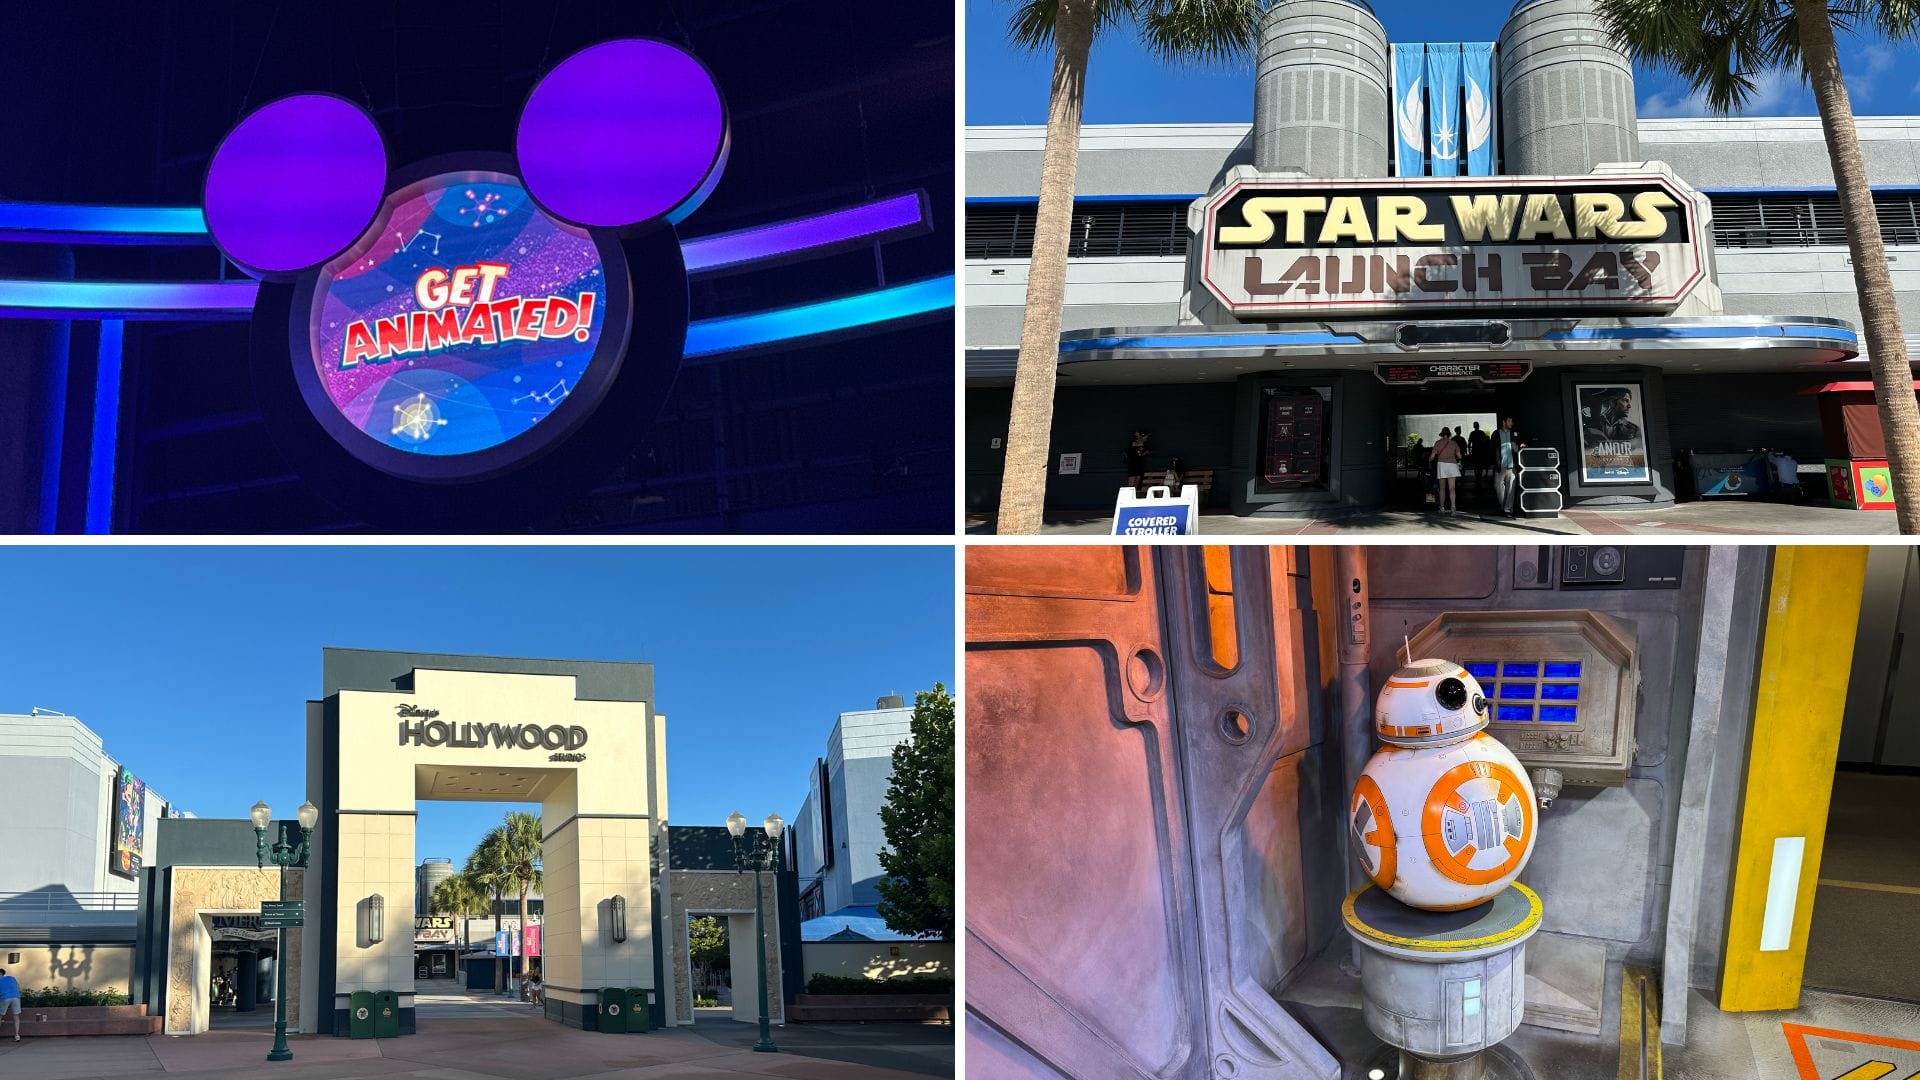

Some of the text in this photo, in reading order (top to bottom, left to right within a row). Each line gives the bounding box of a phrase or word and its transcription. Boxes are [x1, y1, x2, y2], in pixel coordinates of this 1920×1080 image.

[1219, 191, 1680, 244] STAR WARS
[416, 261, 511, 310] GET
[1243, 250, 1662, 296] LAUNCH BAY
[341, 291, 597, 368] ANIMATED!
[1429, 364, 1481, 373] CHARACTER
[1128, 515, 1177, 528] COVERED
[398, 719, 589, 751] HOLLYWOOD
[548, 752, 587, 763] STUDIOS
